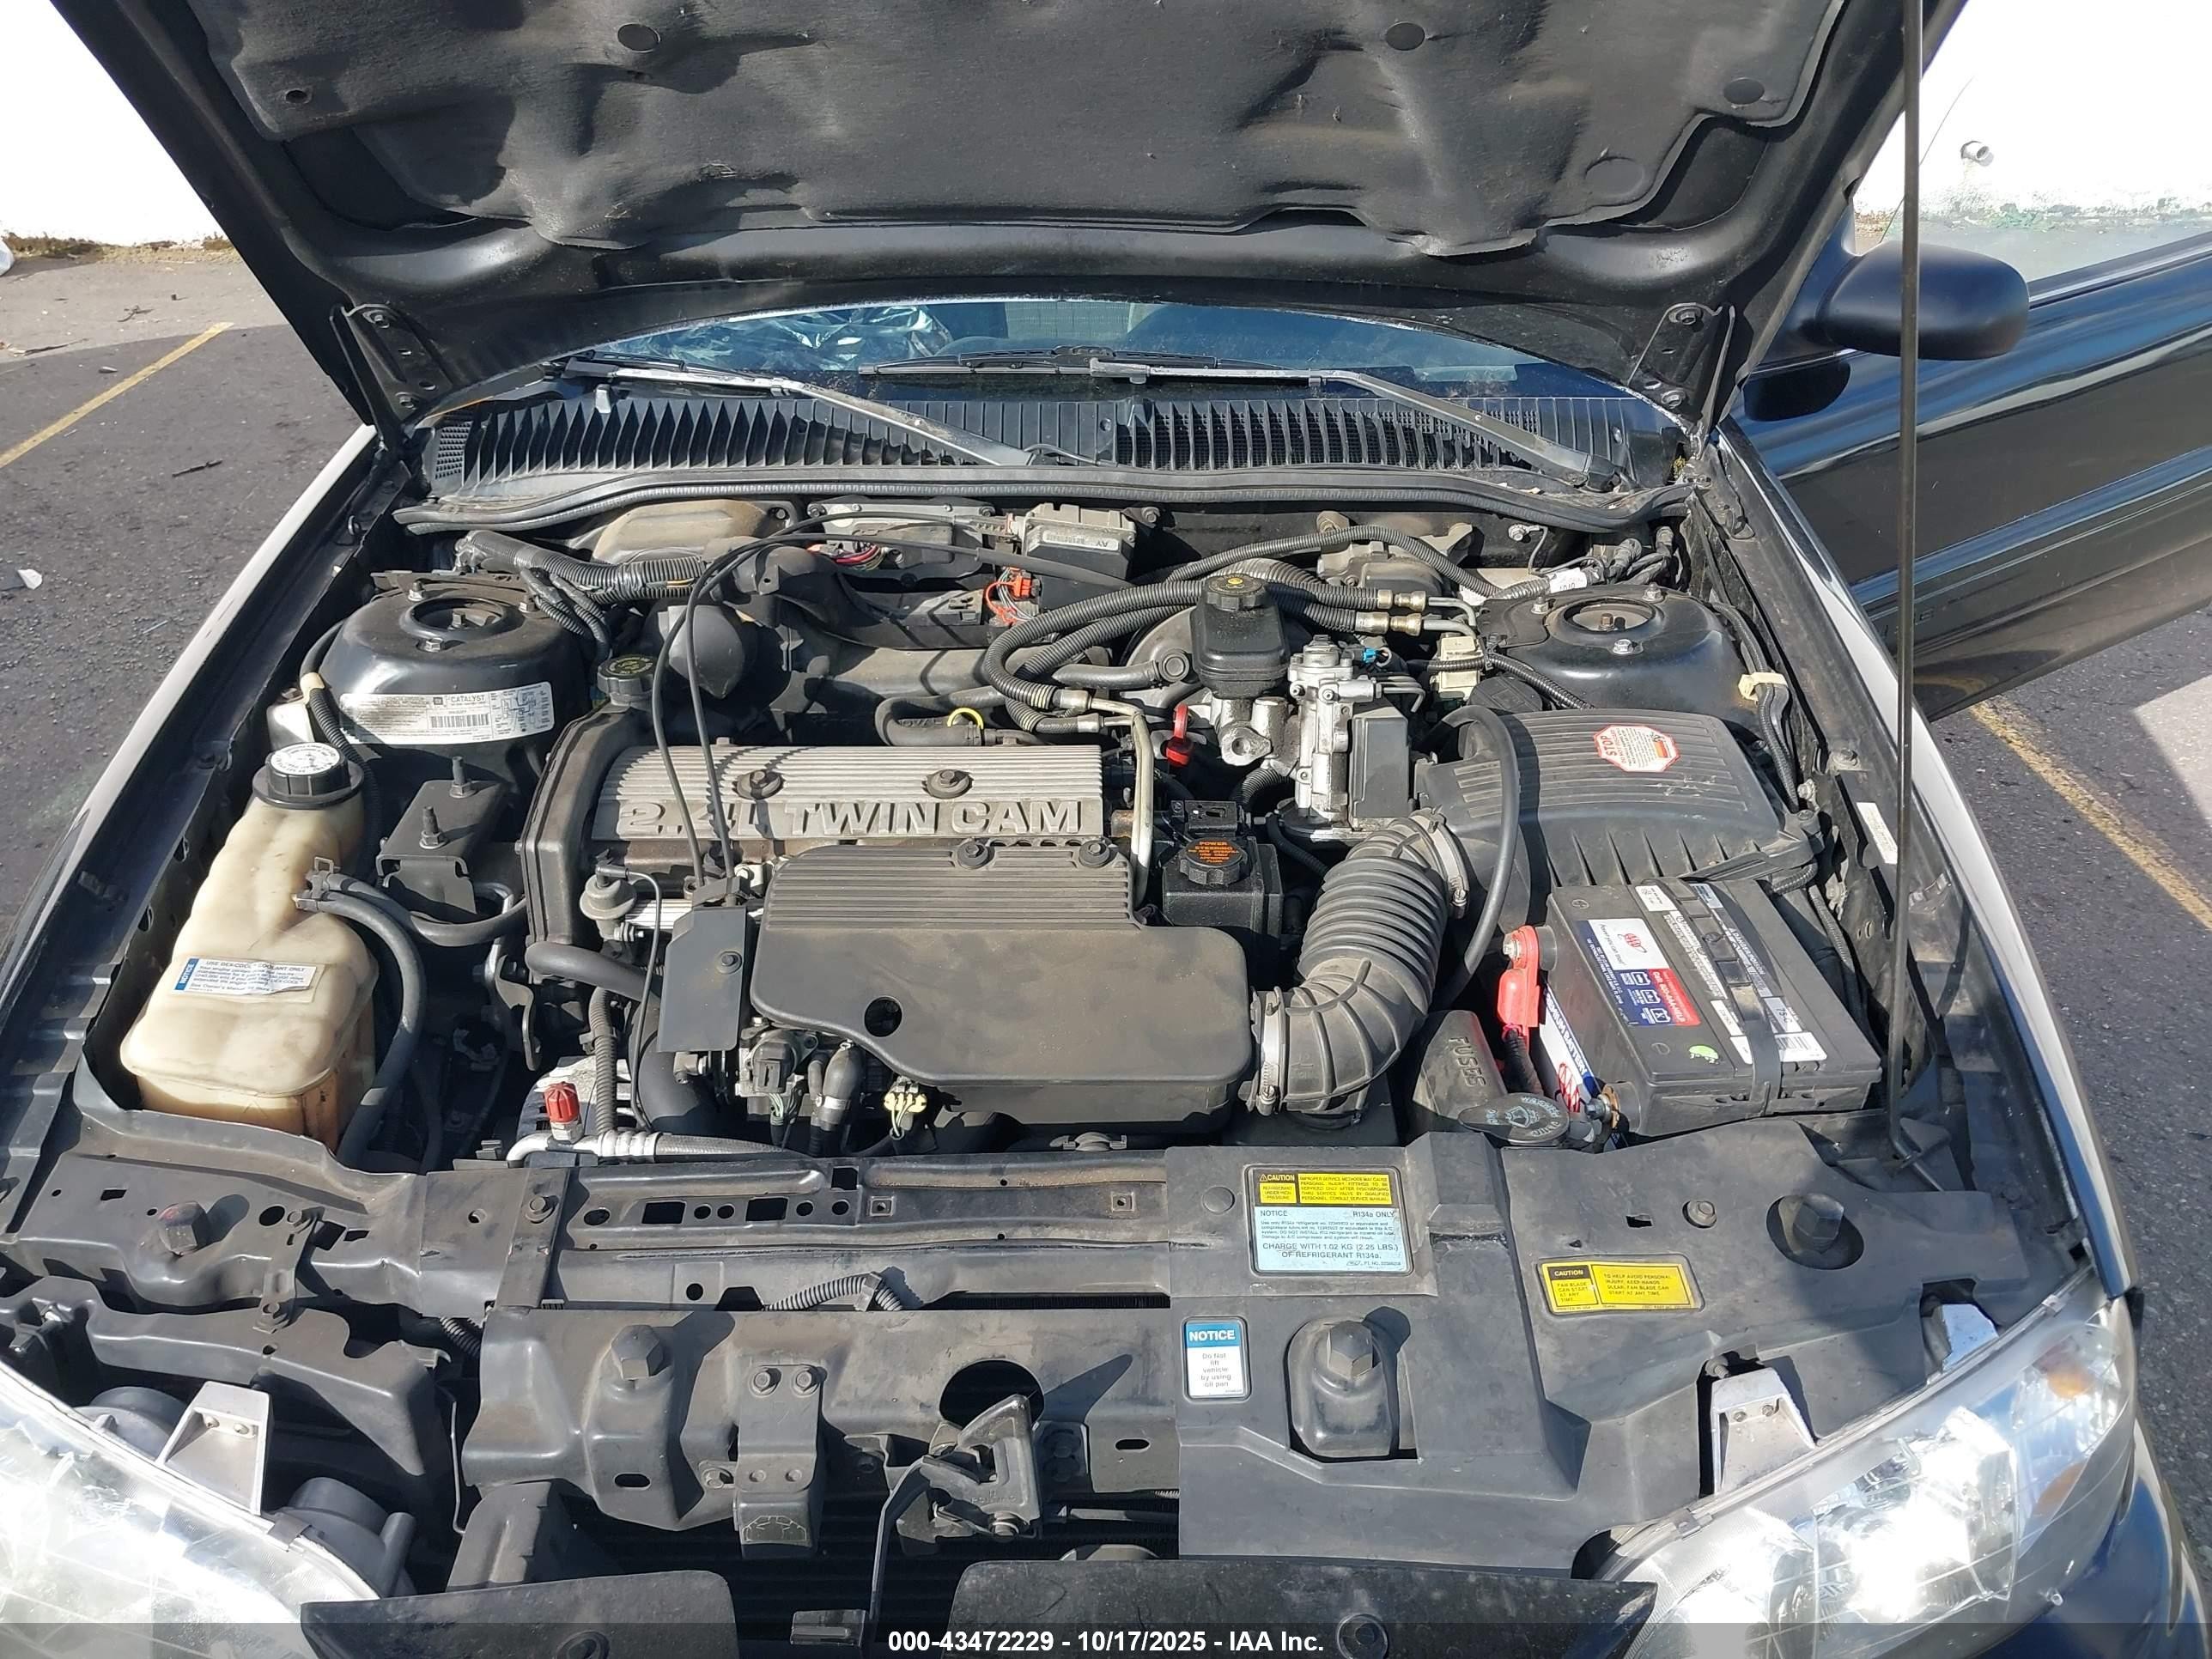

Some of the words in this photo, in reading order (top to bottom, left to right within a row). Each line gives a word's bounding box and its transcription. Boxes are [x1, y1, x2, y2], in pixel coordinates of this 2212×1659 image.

[1600, 736, 1617, 756] STOP
[785, 801, 943, 835] TWIN
[951, 800, 1082, 835] CAM
[179, 963, 194, 984] NOTICE
[1448, 1036, 1486, 1087] FUSES
[1563, 1033, 1587, 1076] BATTERY
[1189, 1330, 1235, 1341] NOTICE
